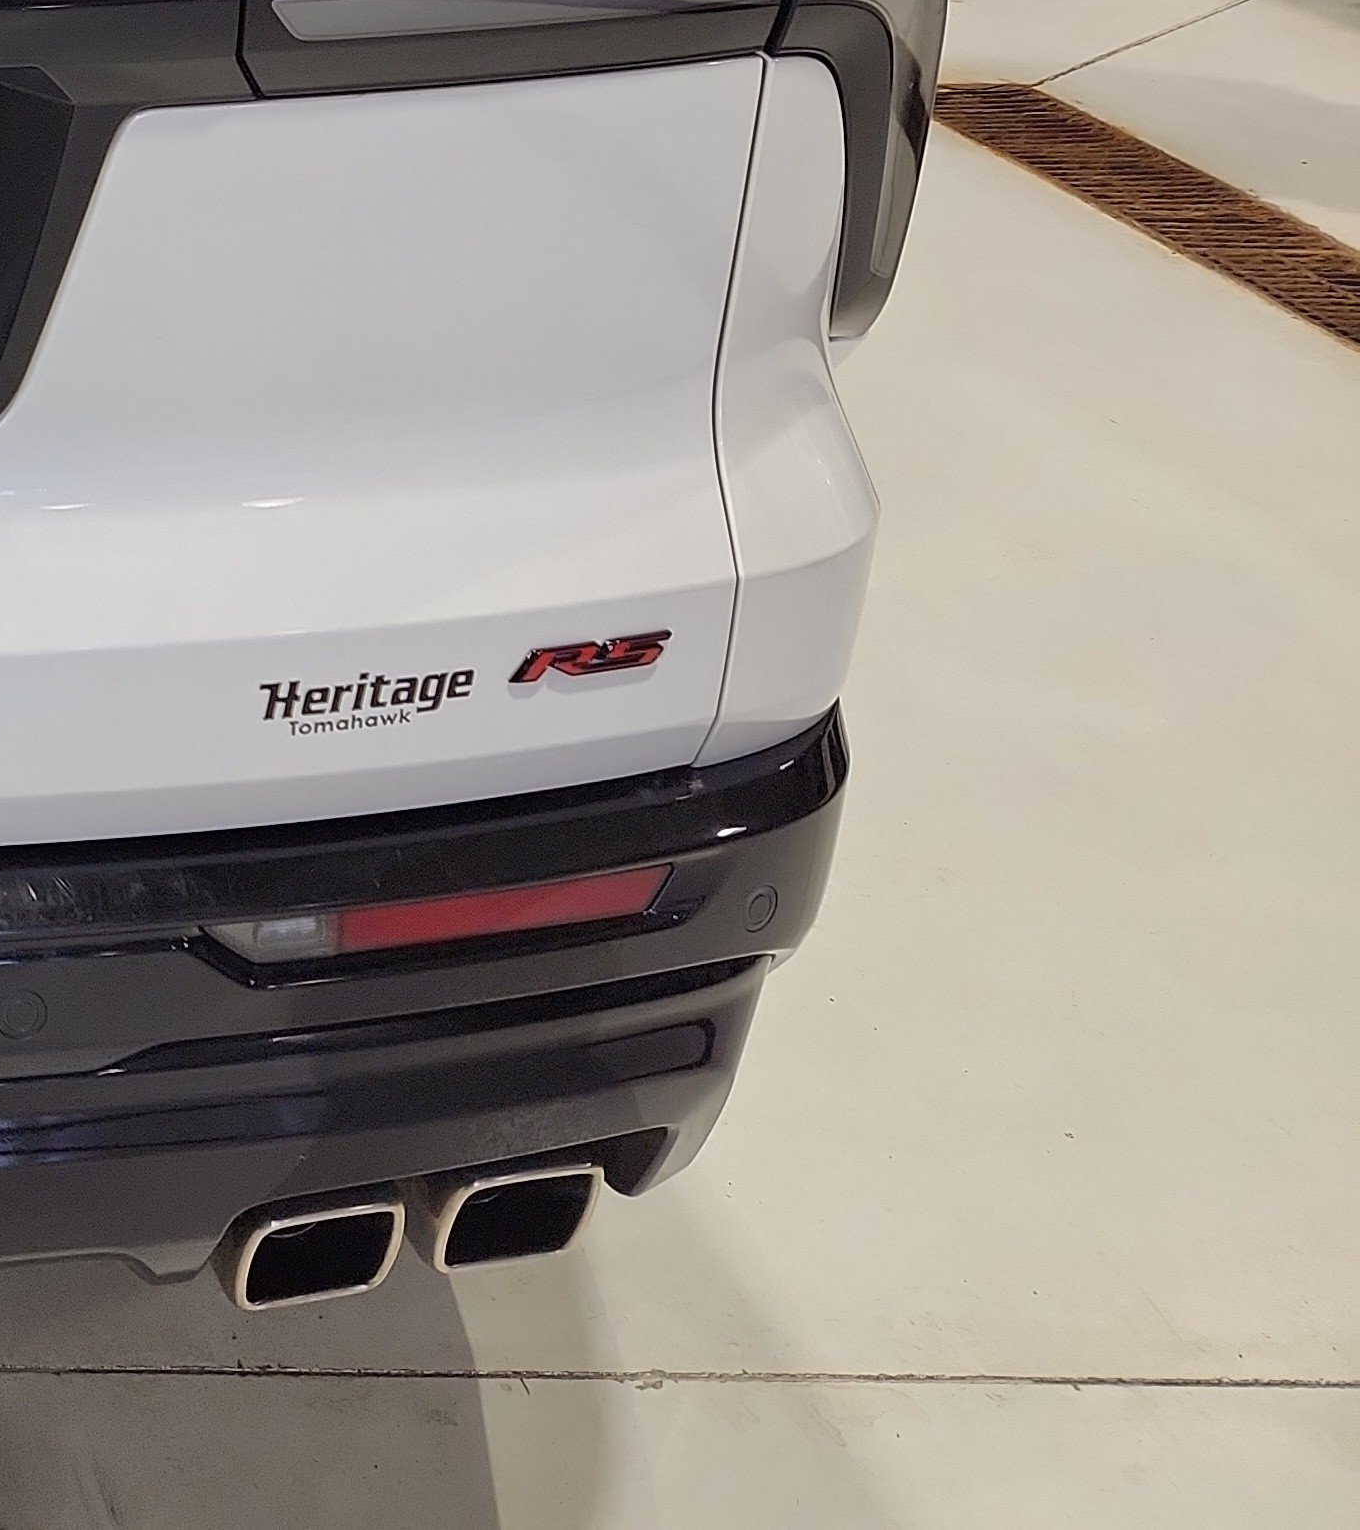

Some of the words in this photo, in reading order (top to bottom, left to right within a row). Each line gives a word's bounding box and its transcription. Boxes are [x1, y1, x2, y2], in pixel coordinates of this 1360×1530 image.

[508, 629, 673, 683] RS
[260, 669, 476, 721] Heritage
[289, 708, 412, 737] Tomahawk
